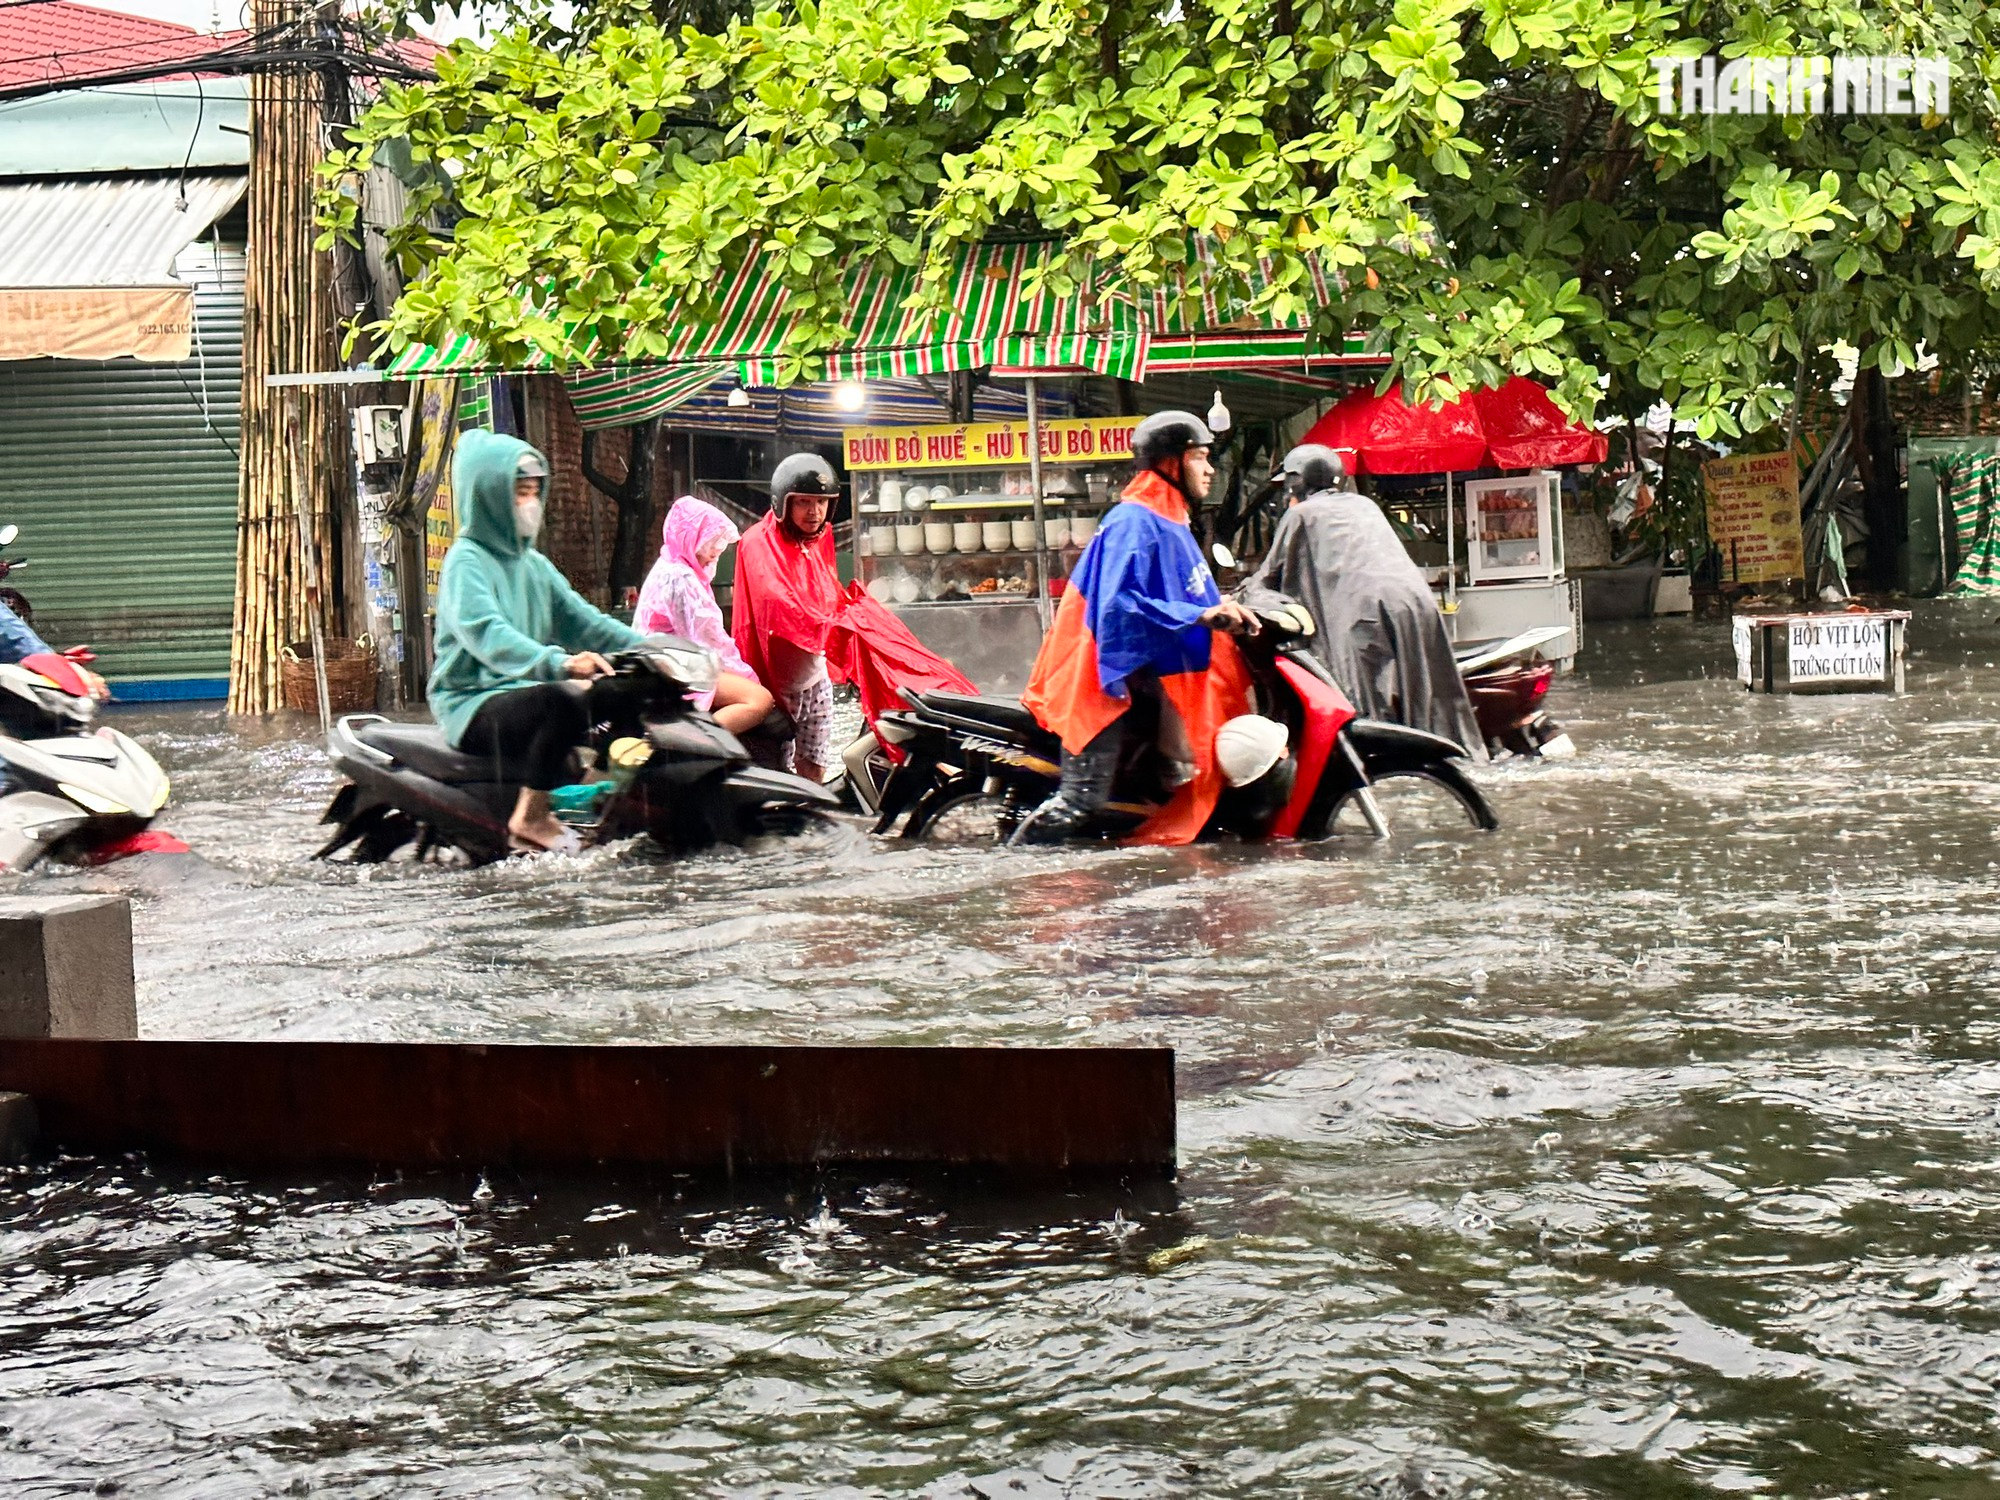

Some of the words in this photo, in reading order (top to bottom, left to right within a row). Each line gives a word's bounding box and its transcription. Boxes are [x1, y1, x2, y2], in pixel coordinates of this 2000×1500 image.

[848, 433, 890, 465] BÚN
[895, 430, 922, 463] BÒ
[927, 427, 967, 461] HUẾ
[987, 423, 1013, 458] HỦ
[1018, 423, 1062, 457] TẾU
[1067, 423, 1094, 455] BÒ
[1750, 457, 1789, 472] KHANG
[1793, 621, 1822, 649] HỘT
[1826, 625, 1849, 648] VỊT
[1853, 620, 1881, 647] LỘN
[1792, 654, 1830, 676] TRỨNG
[1833, 653, 1855, 675] CÚT
[1859, 652, 1881, 677] LỘN
